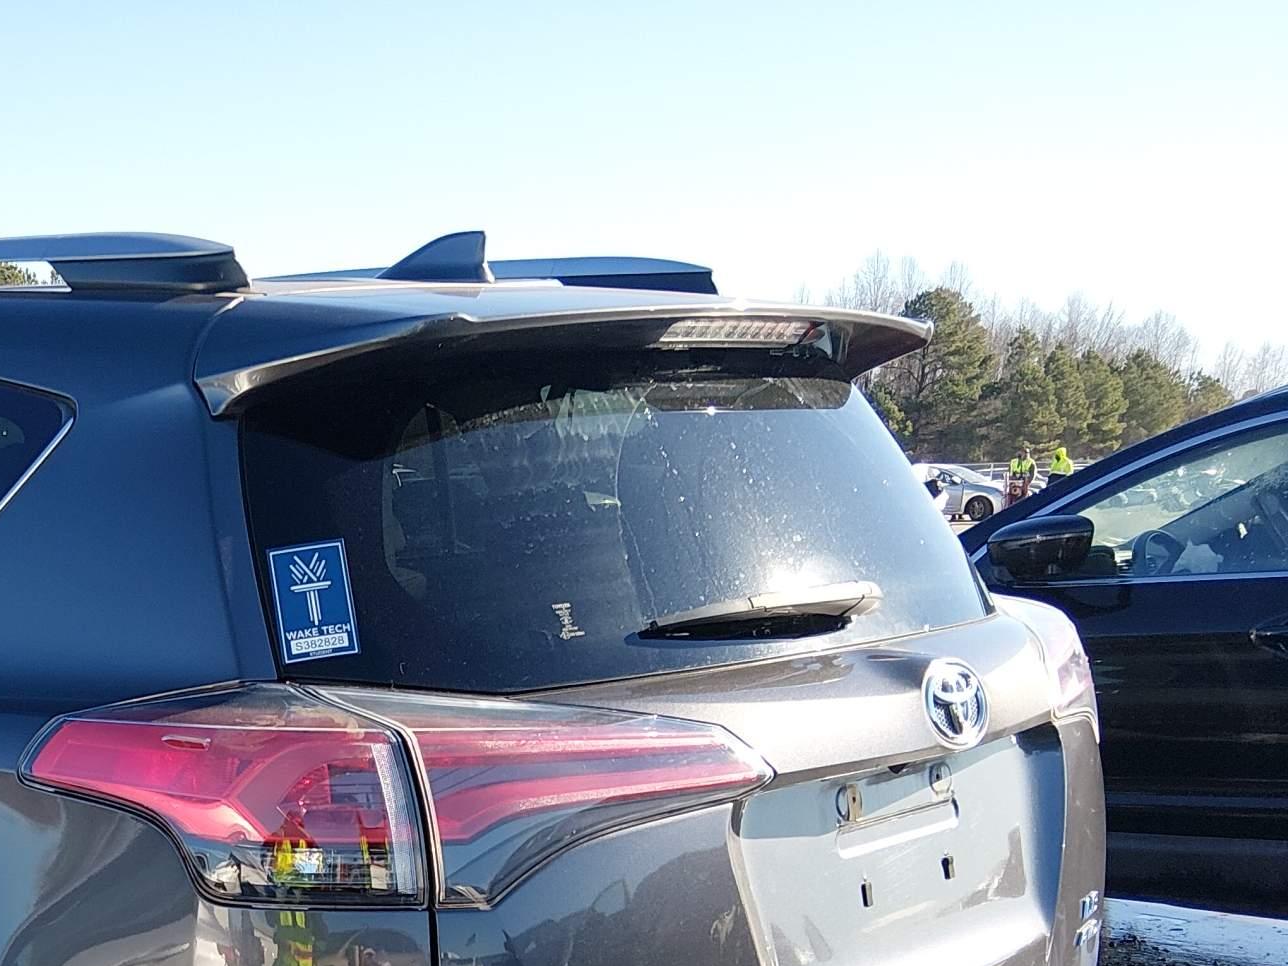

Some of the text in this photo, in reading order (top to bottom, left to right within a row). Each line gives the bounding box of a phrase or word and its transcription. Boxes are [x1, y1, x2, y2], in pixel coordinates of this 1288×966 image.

[285, 623, 351, 640] WAKE TECH
[295, 636, 345, 652] S382828
